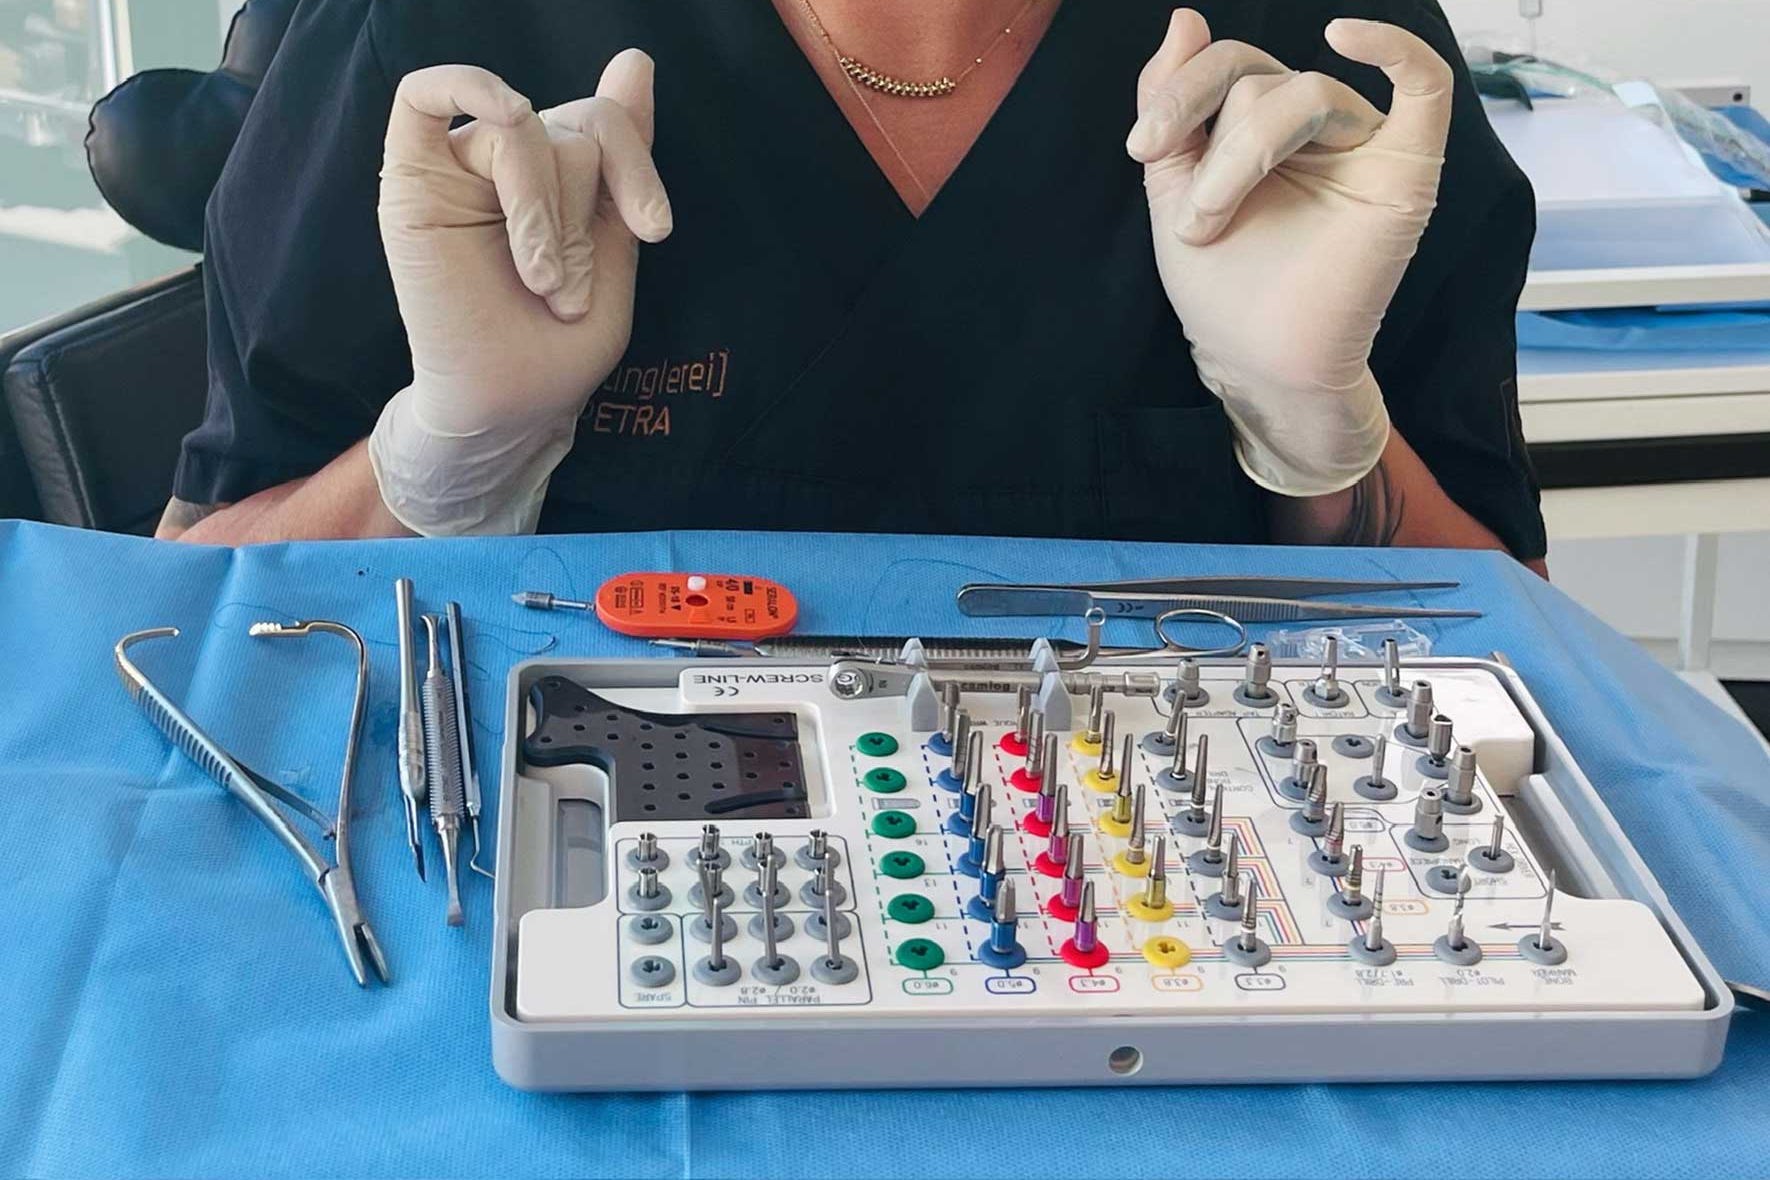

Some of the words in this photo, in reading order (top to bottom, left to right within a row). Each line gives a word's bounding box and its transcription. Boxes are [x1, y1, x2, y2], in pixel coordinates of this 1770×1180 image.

[692, 674, 823, 685] SCREW-LINE
[960, 680, 1011, 692] camlog
[635, 991, 672, 1002] SPARE
[737, 994, 758, 1005] PIN
[765, 994, 821, 1005] PARALLEL
